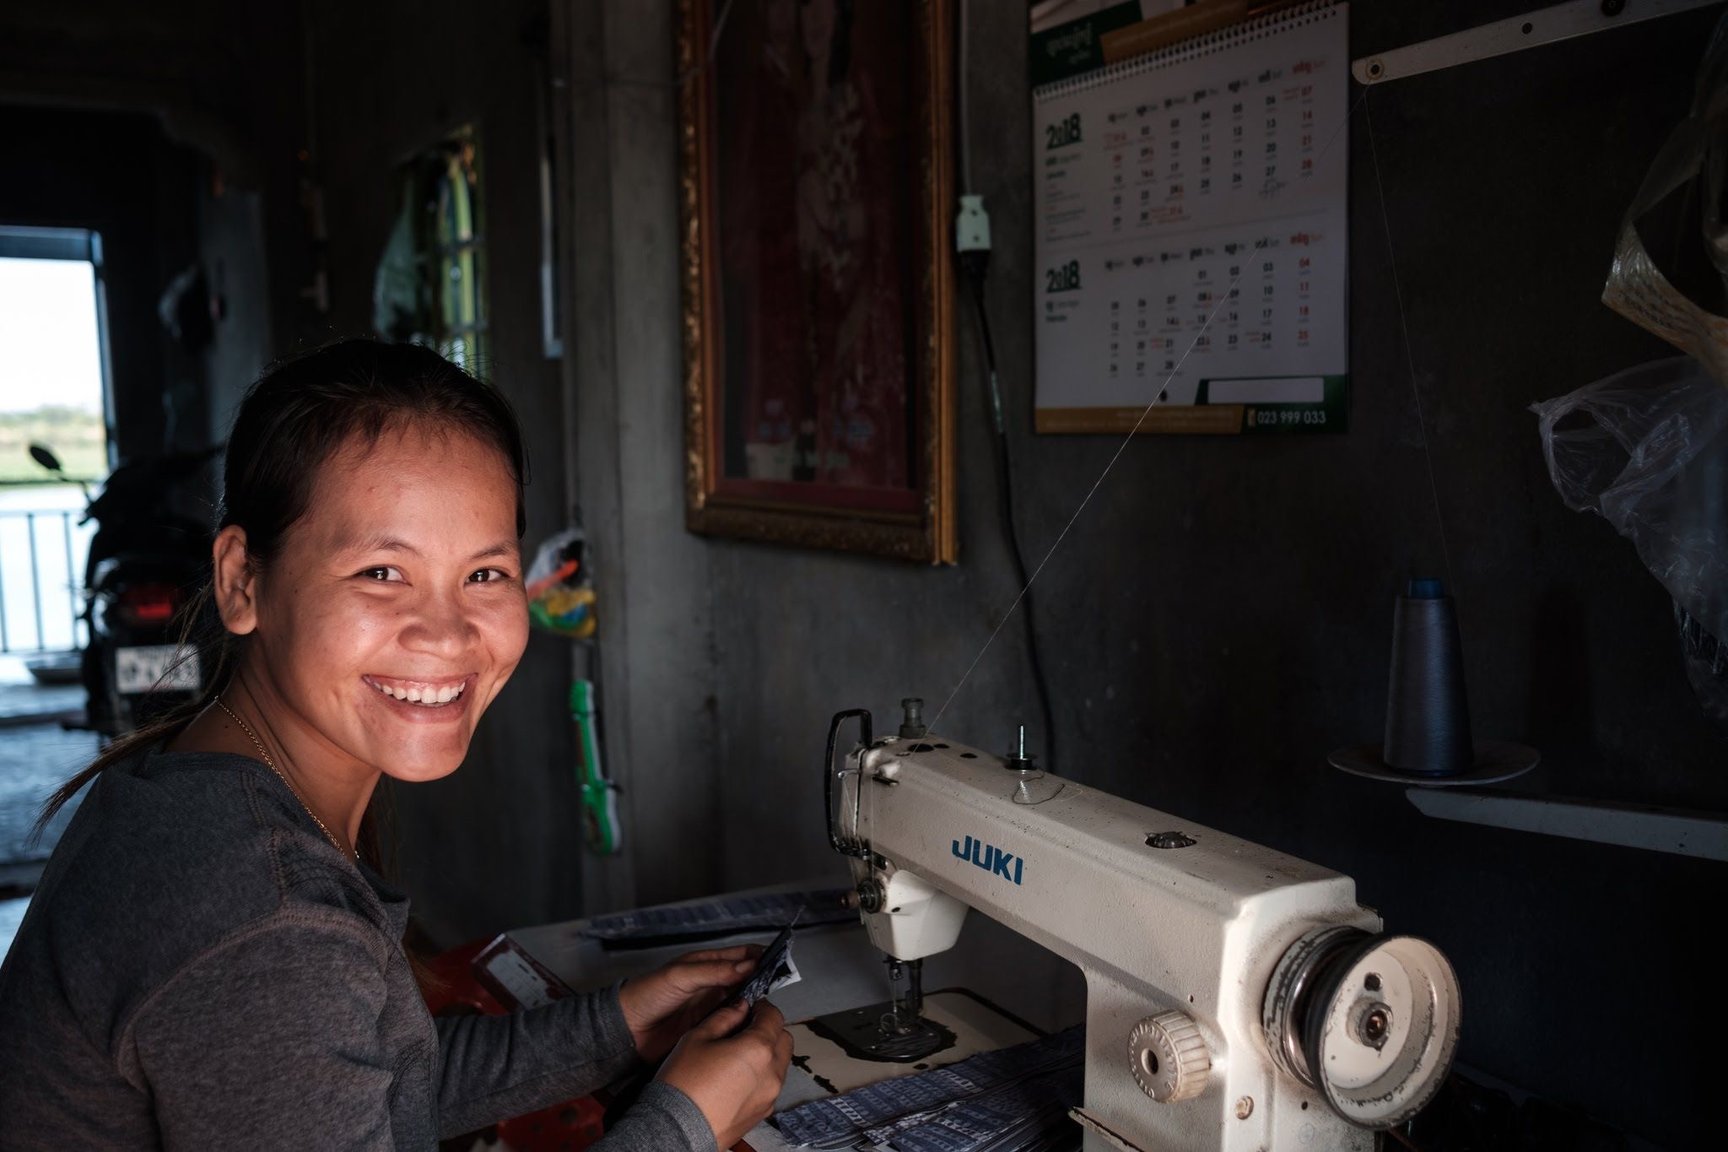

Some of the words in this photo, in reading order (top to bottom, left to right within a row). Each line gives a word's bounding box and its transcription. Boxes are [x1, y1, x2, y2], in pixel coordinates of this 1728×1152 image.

[1047, 113, 1081, 150] 2018
[1046, 260, 1080, 293] 2018
[1257, 410, 1277, 424] 023
[1280, 410, 1300, 424] 999
[1304, 410, 1326, 424] 033
[952, 835, 1023, 885] JUKI
